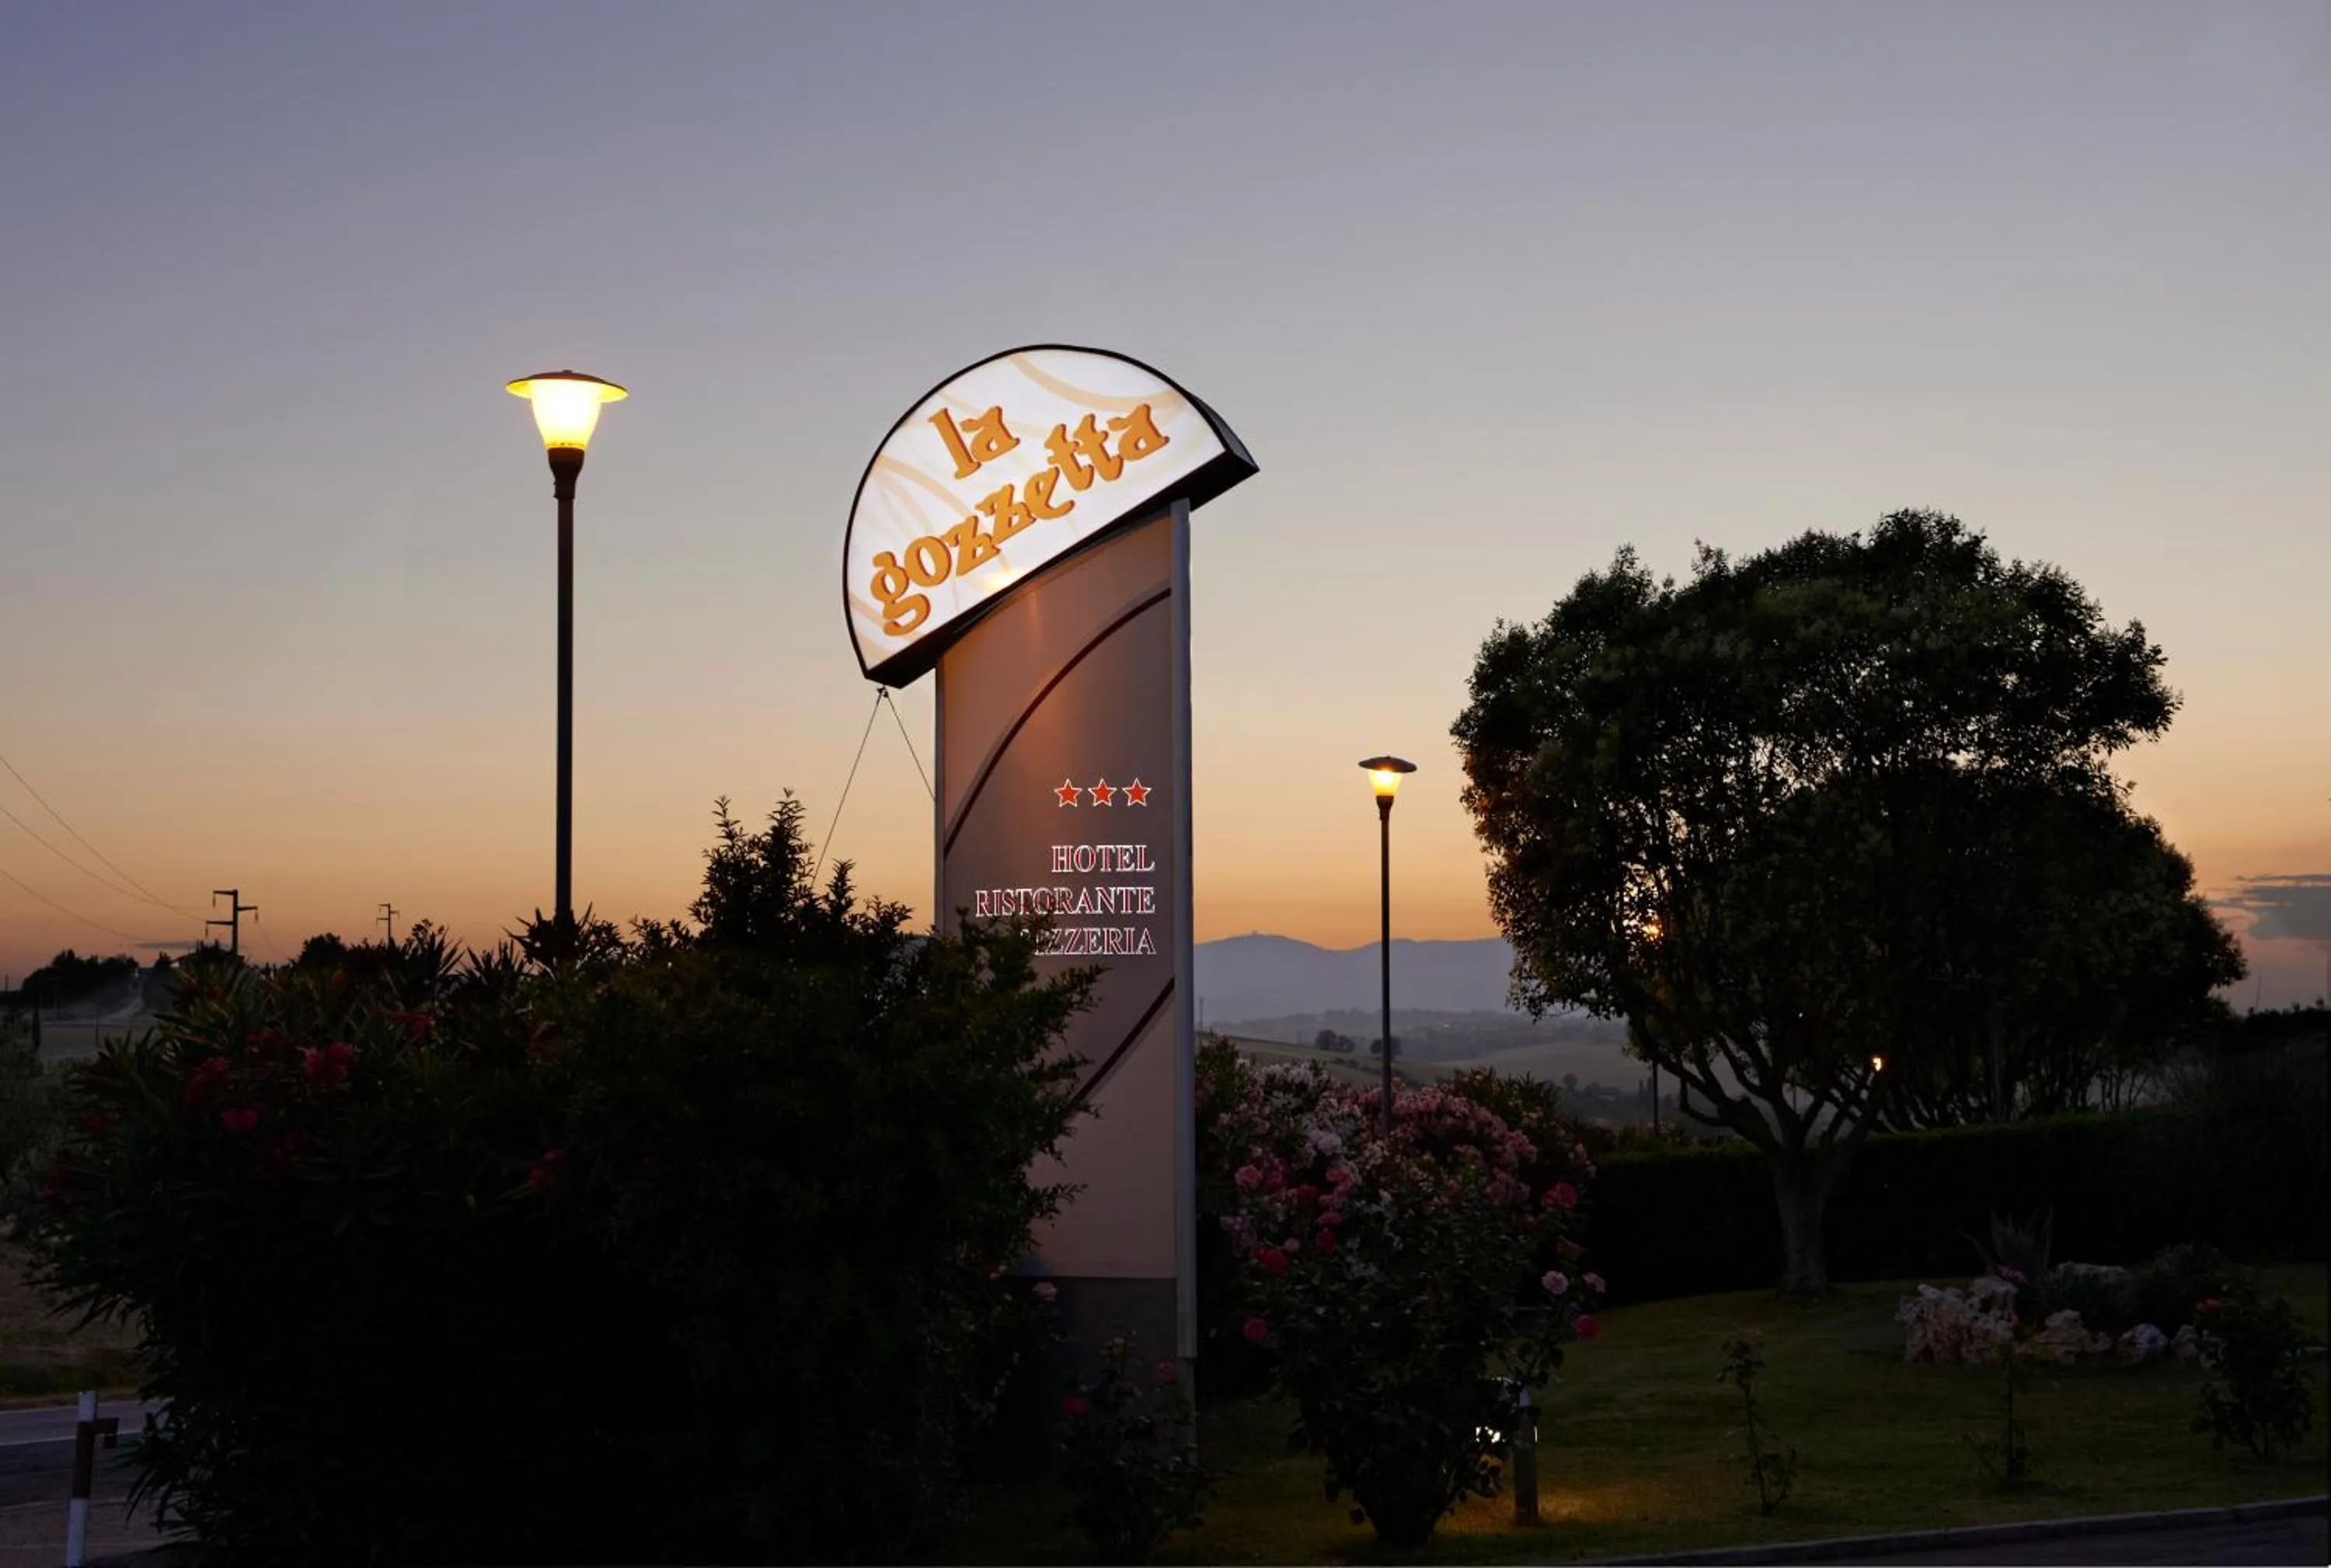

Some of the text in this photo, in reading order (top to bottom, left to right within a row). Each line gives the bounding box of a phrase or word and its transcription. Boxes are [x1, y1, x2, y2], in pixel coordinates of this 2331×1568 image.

[929, 406, 1020, 479] la
[870, 404, 1169, 636] gozzetta
[1051, 845, 1155, 873] HOTEL
[974, 887, 1156, 918] RISTORANTE
[1020, 927, 1157, 956] IZZERIA
